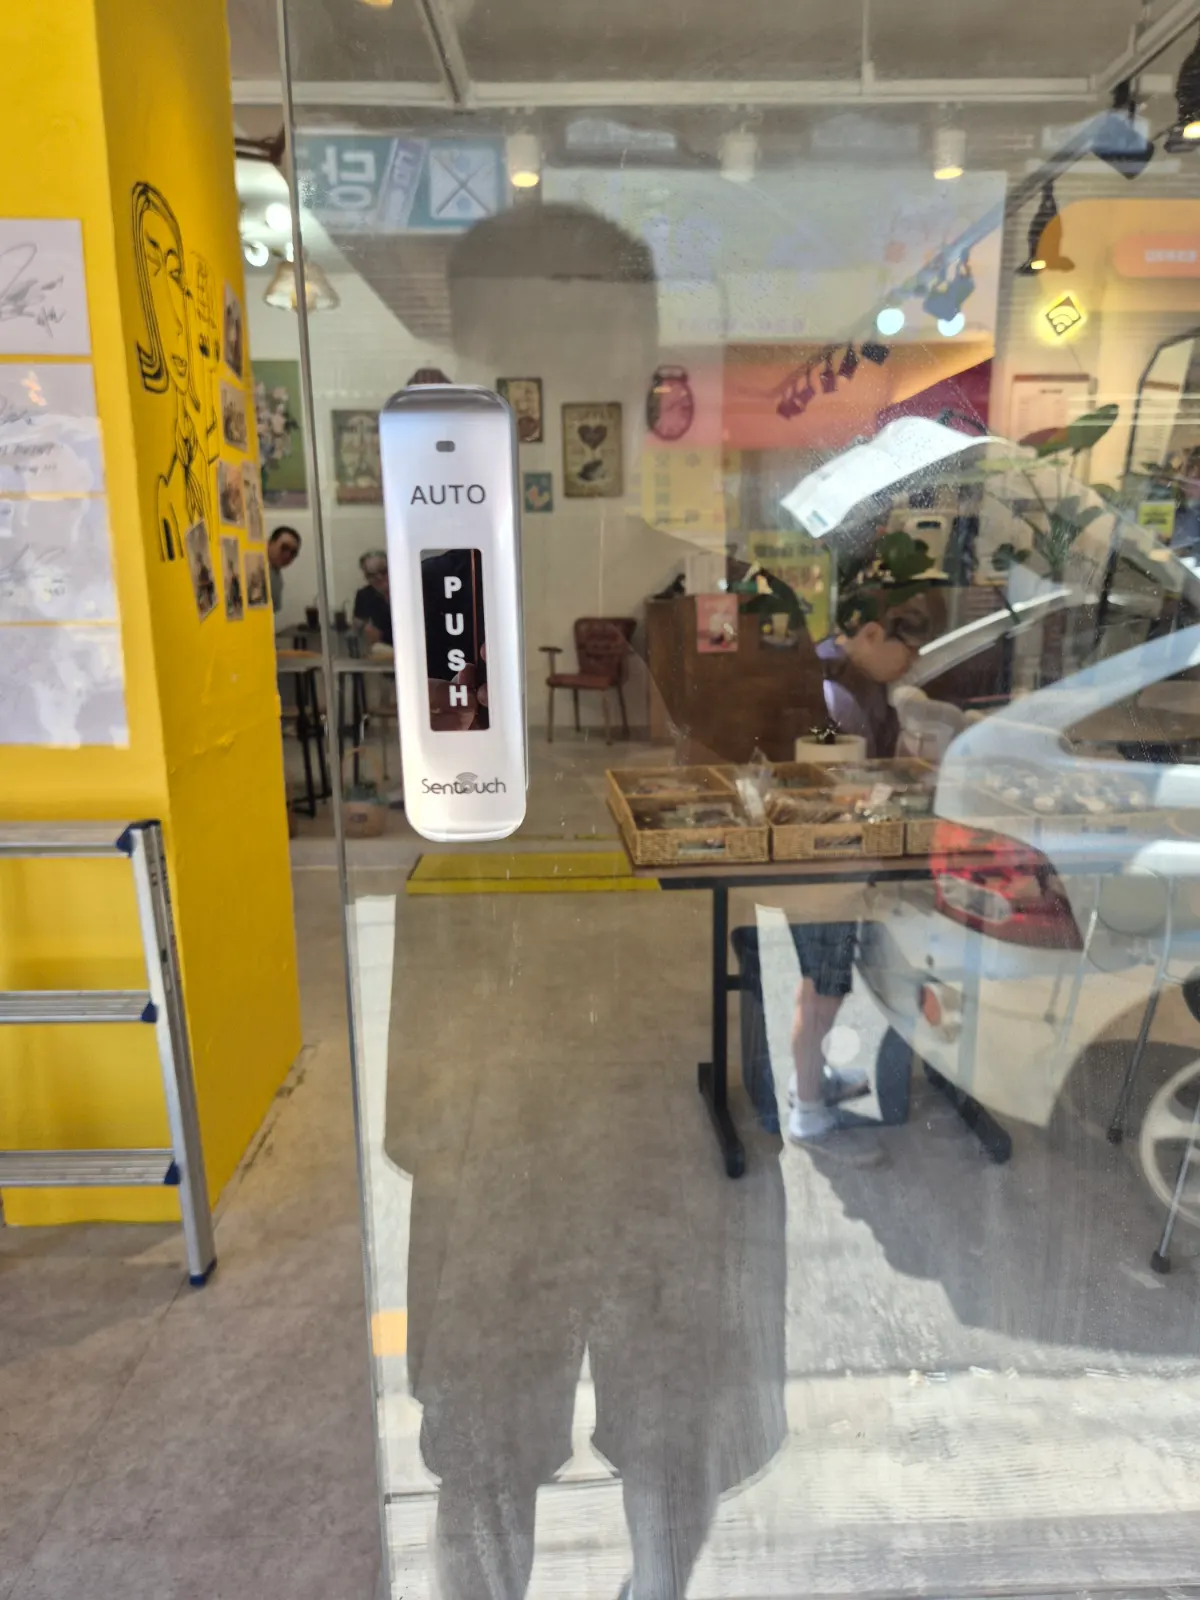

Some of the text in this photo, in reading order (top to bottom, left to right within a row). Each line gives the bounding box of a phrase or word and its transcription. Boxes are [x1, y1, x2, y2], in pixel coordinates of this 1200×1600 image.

[410, 484, 486, 505] AUTO
[443, 575, 469, 707] PUSH
[421, 777, 507, 795] Sentouch
